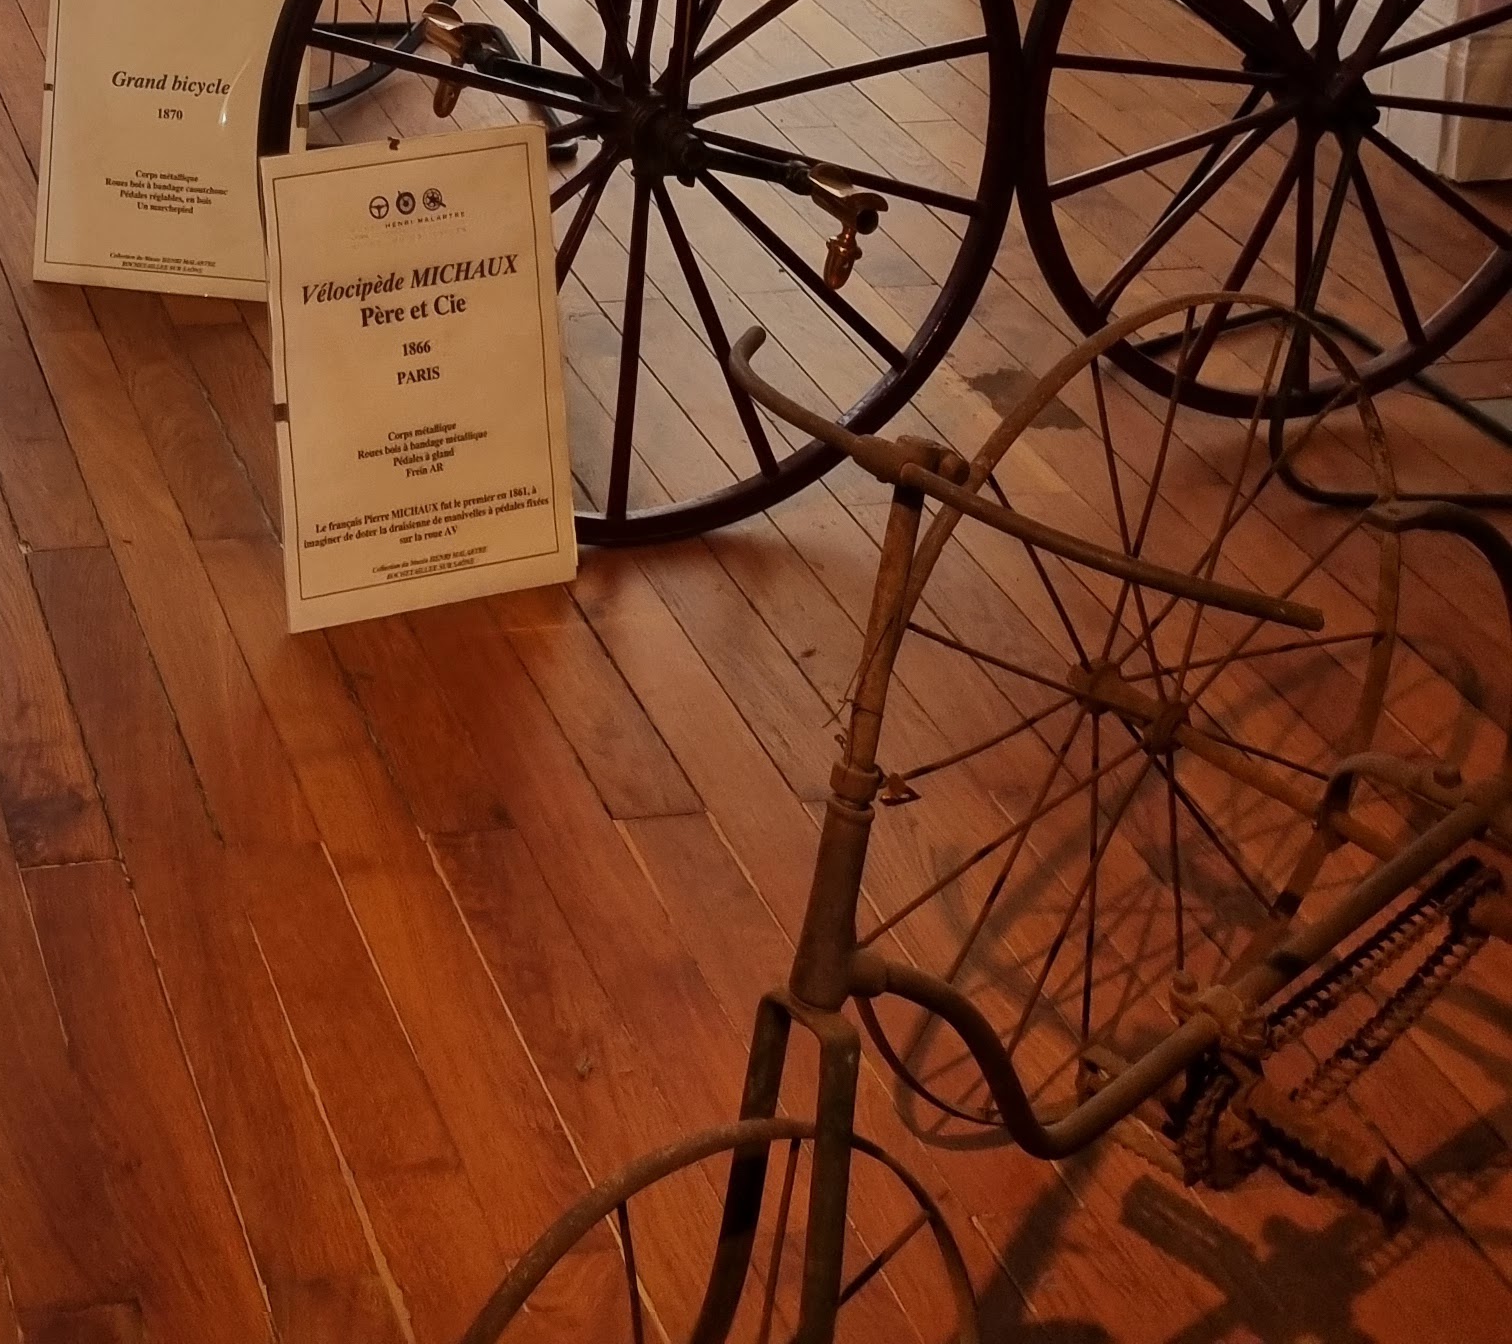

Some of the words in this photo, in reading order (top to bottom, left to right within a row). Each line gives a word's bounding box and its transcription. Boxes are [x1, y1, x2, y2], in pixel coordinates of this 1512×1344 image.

[112, 70, 168, 90] Grand
[171, 75, 231, 97] bicycle
[158, 108, 183, 120] 1870
[135, 170, 158, 180] Corps
[385, 220, 413, 228] HENRI
[418, 212, 465, 223] MALARTRE
[302, 273, 405, 305] Vélocipède
[410, 254, 518, 289] MICHAUX
[360, 305, 405, 327] Père
[410, 300, 428, 320] et
[433, 294, 467, 316] Cie
[402, 340, 431, 357] 1866
[397, 366, 440, 385] PARIS
[388, 430, 413, 441] Corps
[415, 422, 456, 436] métallique
[358, 449, 383, 460] Roues
[385, 445, 401, 454] bois
[403, 443, 408, 452] à
[410, 438, 444, 450] bandage
[446, 431, 488, 444] métallique
[393, 454, 423, 467] Pédales
[425, 452, 430, 461] à
[432, 447, 455, 461] gland
[406, 467, 428, 478] Frein
[430, 463, 444, 474] AR
[315, 524, 327, 533] Le
[329, 517, 363, 531] français
[364, 514, 389, 525] Pierre
[391, 503, 438, 518] MICHAUX
[440, 502, 452, 510] fut
[454, 499, 461, 508] le
[463, 494, 496, 508] premier
[509, 487, 530, 498] 1861,
[532, 485, 537, 494] à
[303, 535, 341, 548] imaginer
[343, 533, 353, 542] de
[355, 529, 377, 539] doter
[379, 526, 387, 534] la
[389, 520, 431, 532] draisienne
[432, 516, 442, 525] de
[444, 508, 486, 523] manivelles
[488, 506, 493, 515] à
[495, 501, 525, 516] pédales
[527, 497, 549, 508] fixées
[399, 535, 413, 544] sur
[415, 533, 422, 542] la
[424, 531, 442, 540] roue
[444, 525, 458, 537] AV
